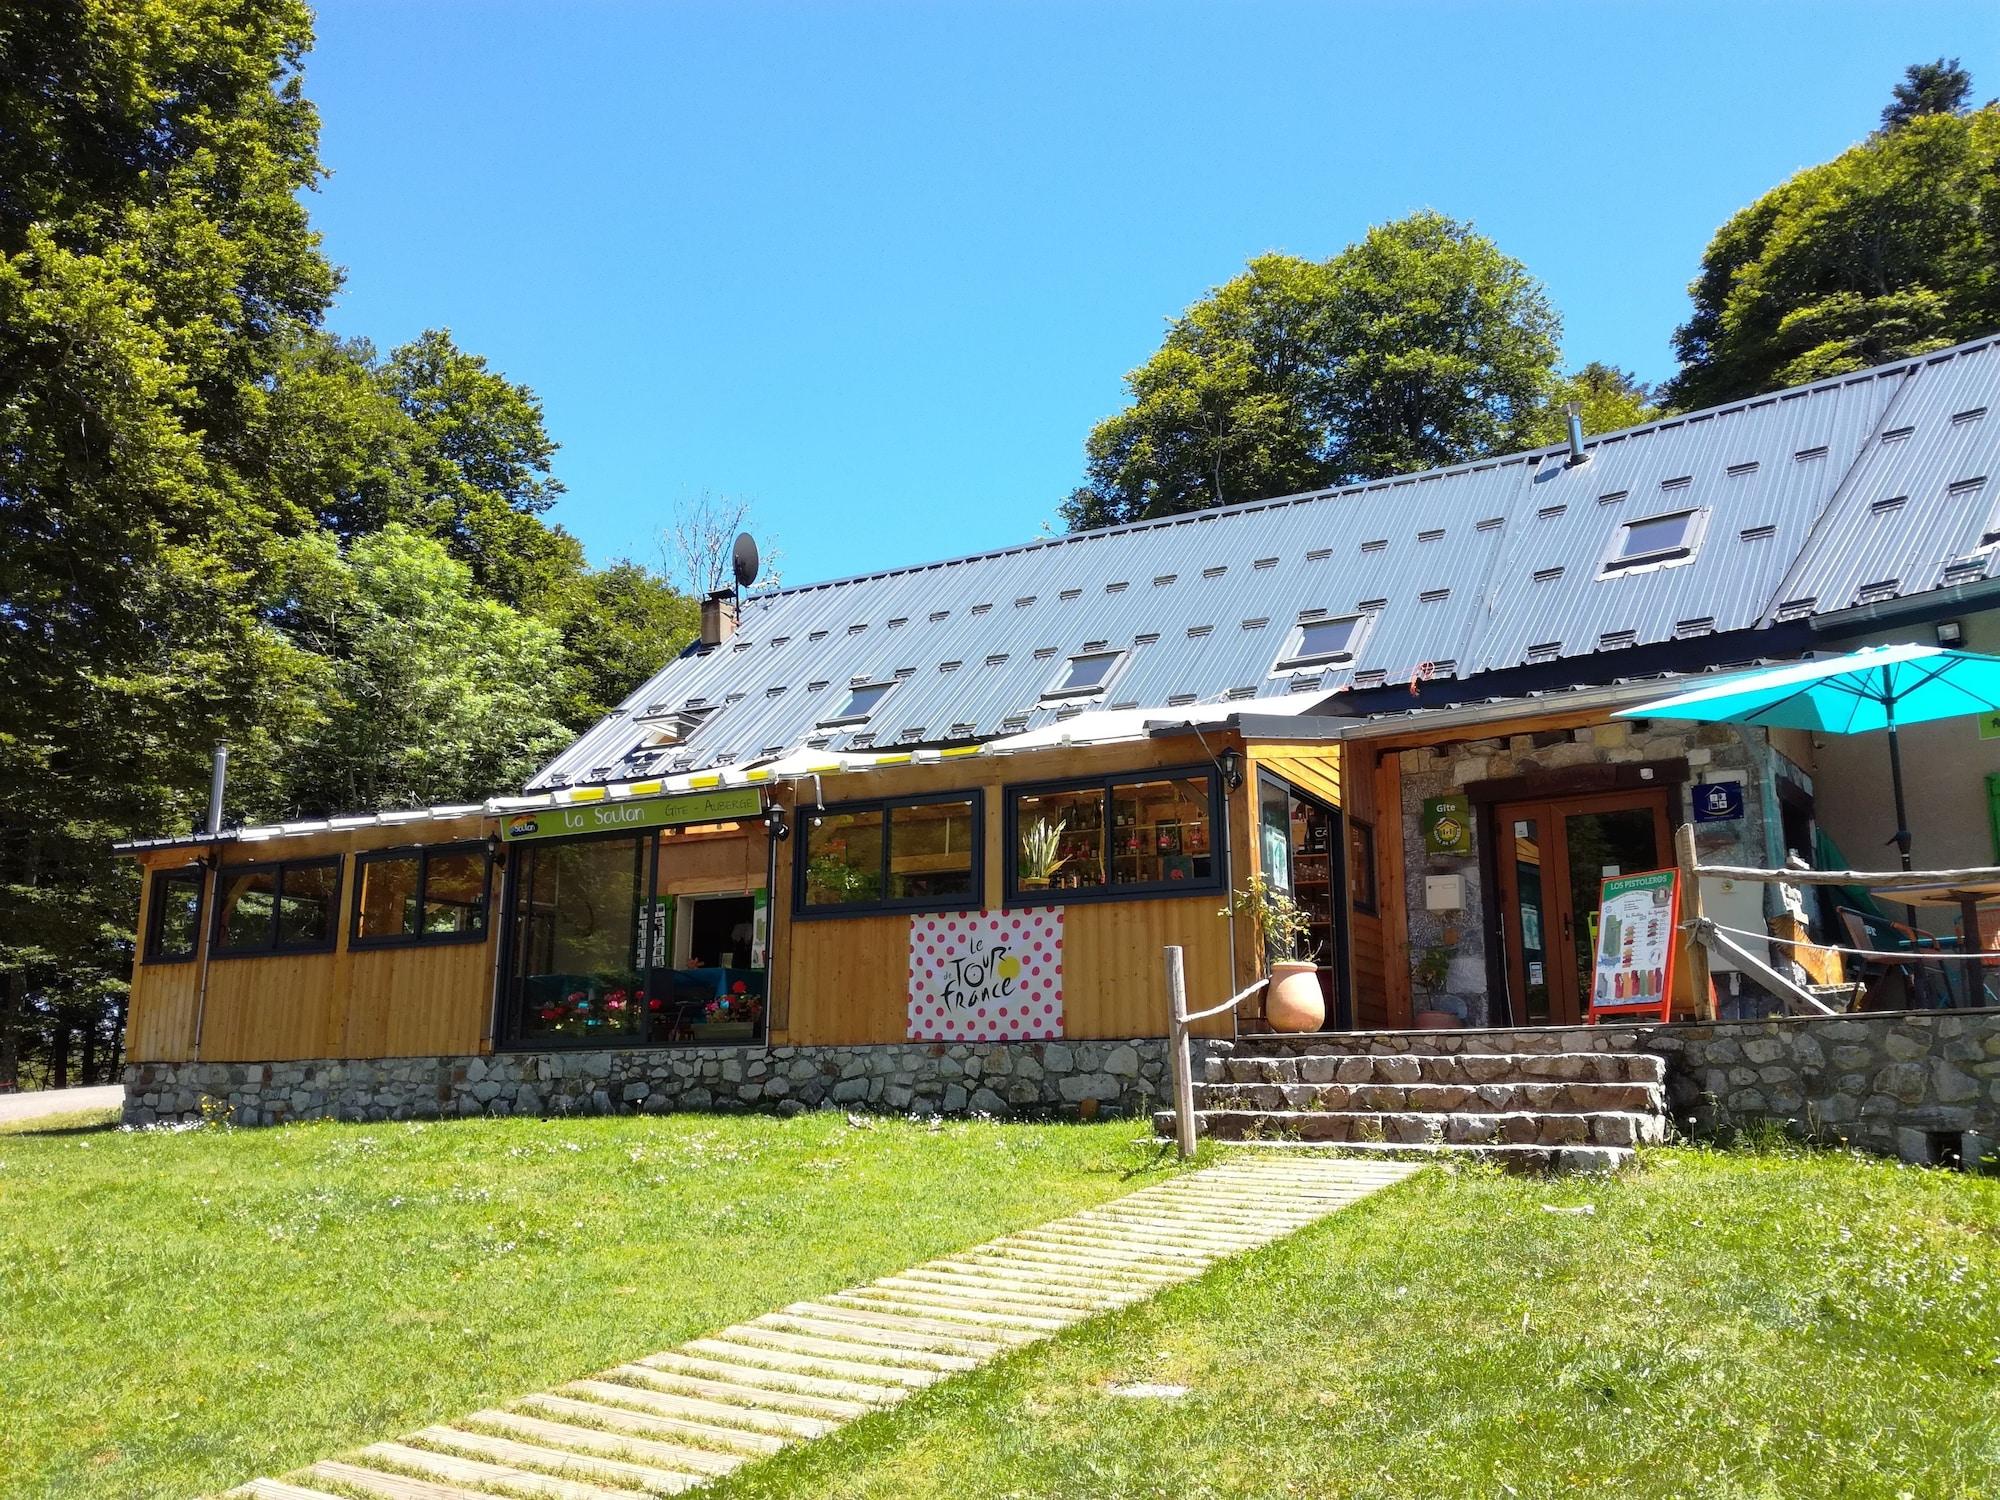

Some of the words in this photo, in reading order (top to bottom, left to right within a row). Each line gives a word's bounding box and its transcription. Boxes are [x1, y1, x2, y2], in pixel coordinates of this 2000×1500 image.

[564, 811, 585, 828] La
[594, 804, 645, 825] Soulan
[1610, 881, 1624, 890] LOS
[1624, 874, 1668, 888] PISTOLEROS
